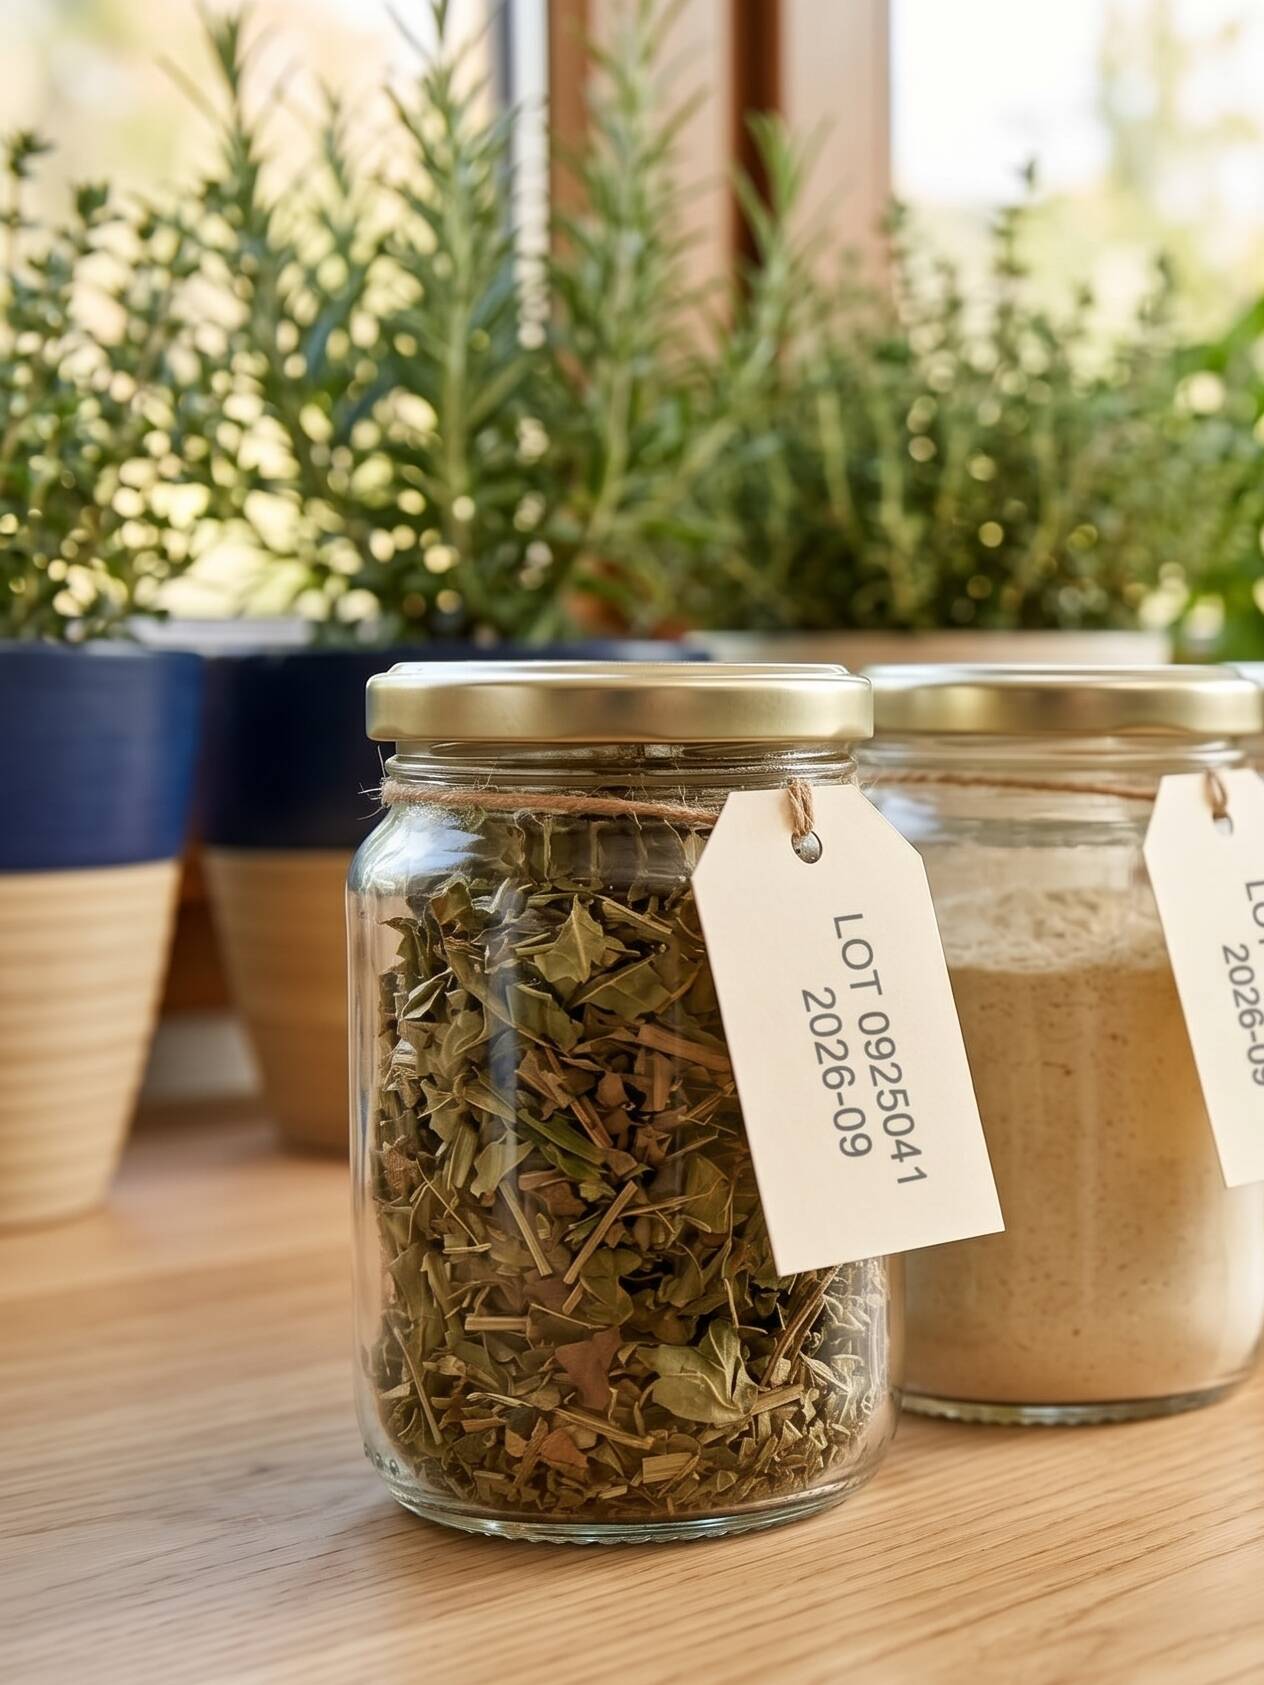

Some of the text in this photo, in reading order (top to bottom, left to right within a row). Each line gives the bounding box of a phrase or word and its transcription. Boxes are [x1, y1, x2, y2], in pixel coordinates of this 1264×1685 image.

[802, 987, 872, 1157] 2026-09
[834, 914, 927, 1183] LOT 0925041
